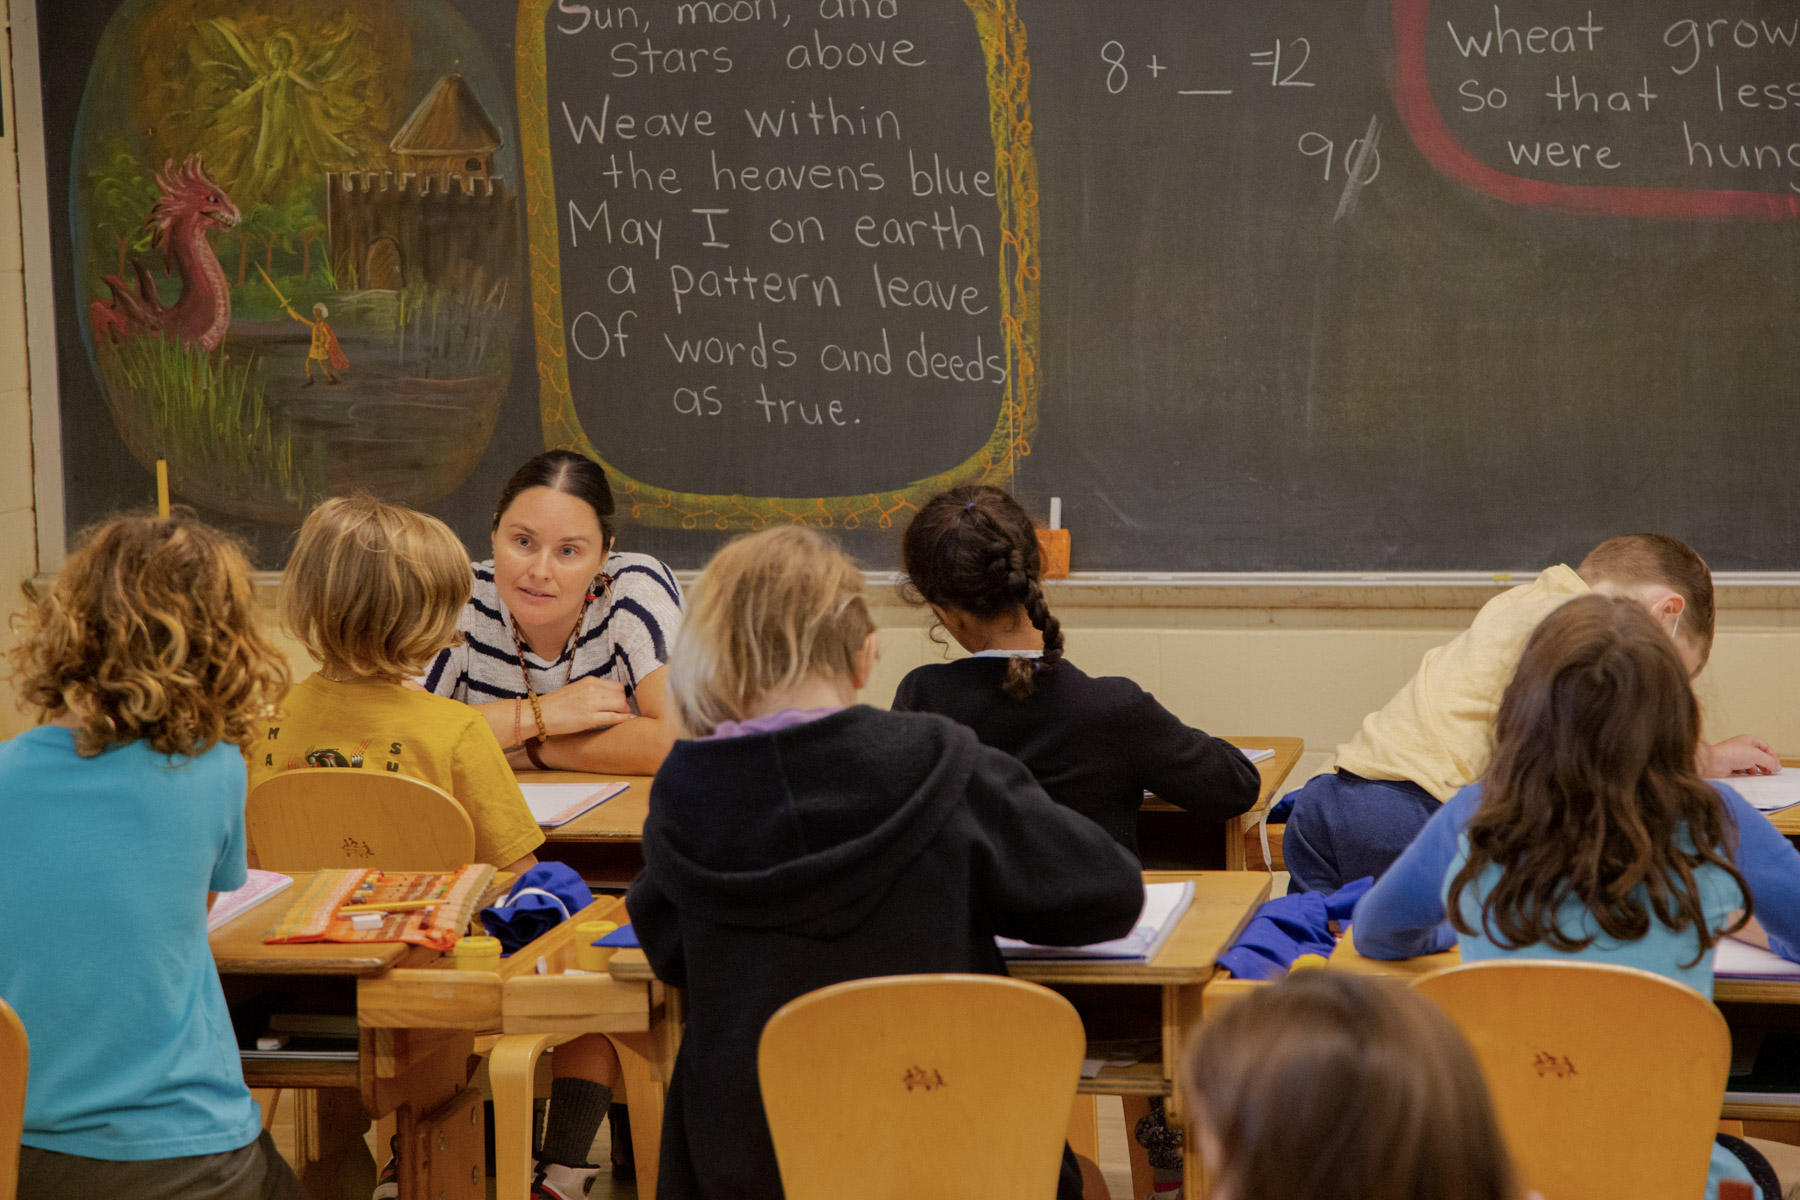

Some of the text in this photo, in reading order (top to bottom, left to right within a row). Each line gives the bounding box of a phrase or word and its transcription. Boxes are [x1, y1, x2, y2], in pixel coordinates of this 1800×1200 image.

[558, 0, 650, 34] Sun,
[677, 0, 791, 27] moon,
[786, 29, 926, 70] above
[1101, 40, 1128, 94] 8
[1546, 75, 1658, 112] that
[562, 94, 900, 143] Weave within
[603, 149, 998, 197] the heavens blue
[1508, 140, 1621, 169] were
[569, 200, 985, 260] May I on earth
[607, 263, 989, 315] a pattern leave
[571, 310, 1008, 384] Of words and deeds
[673, 384, 861, 426] as true.
